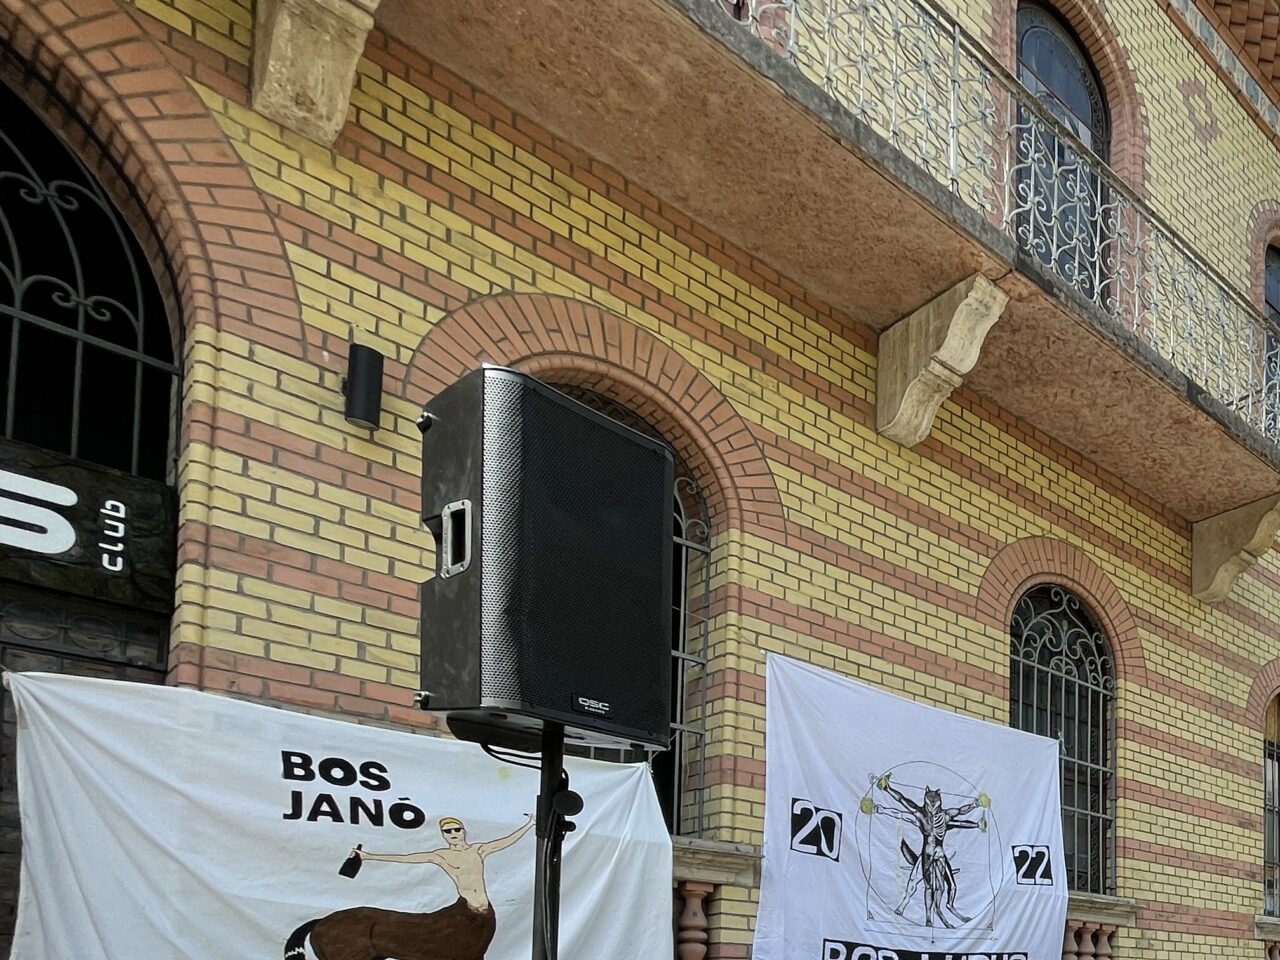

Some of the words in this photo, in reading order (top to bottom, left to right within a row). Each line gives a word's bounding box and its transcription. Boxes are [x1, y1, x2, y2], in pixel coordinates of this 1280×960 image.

[578, 697, 610, 711] QSC
[281, 750, 392, 792] BOS
[791, 799, 842, 860] 20
[1013, 845, 1052, 885] 22
